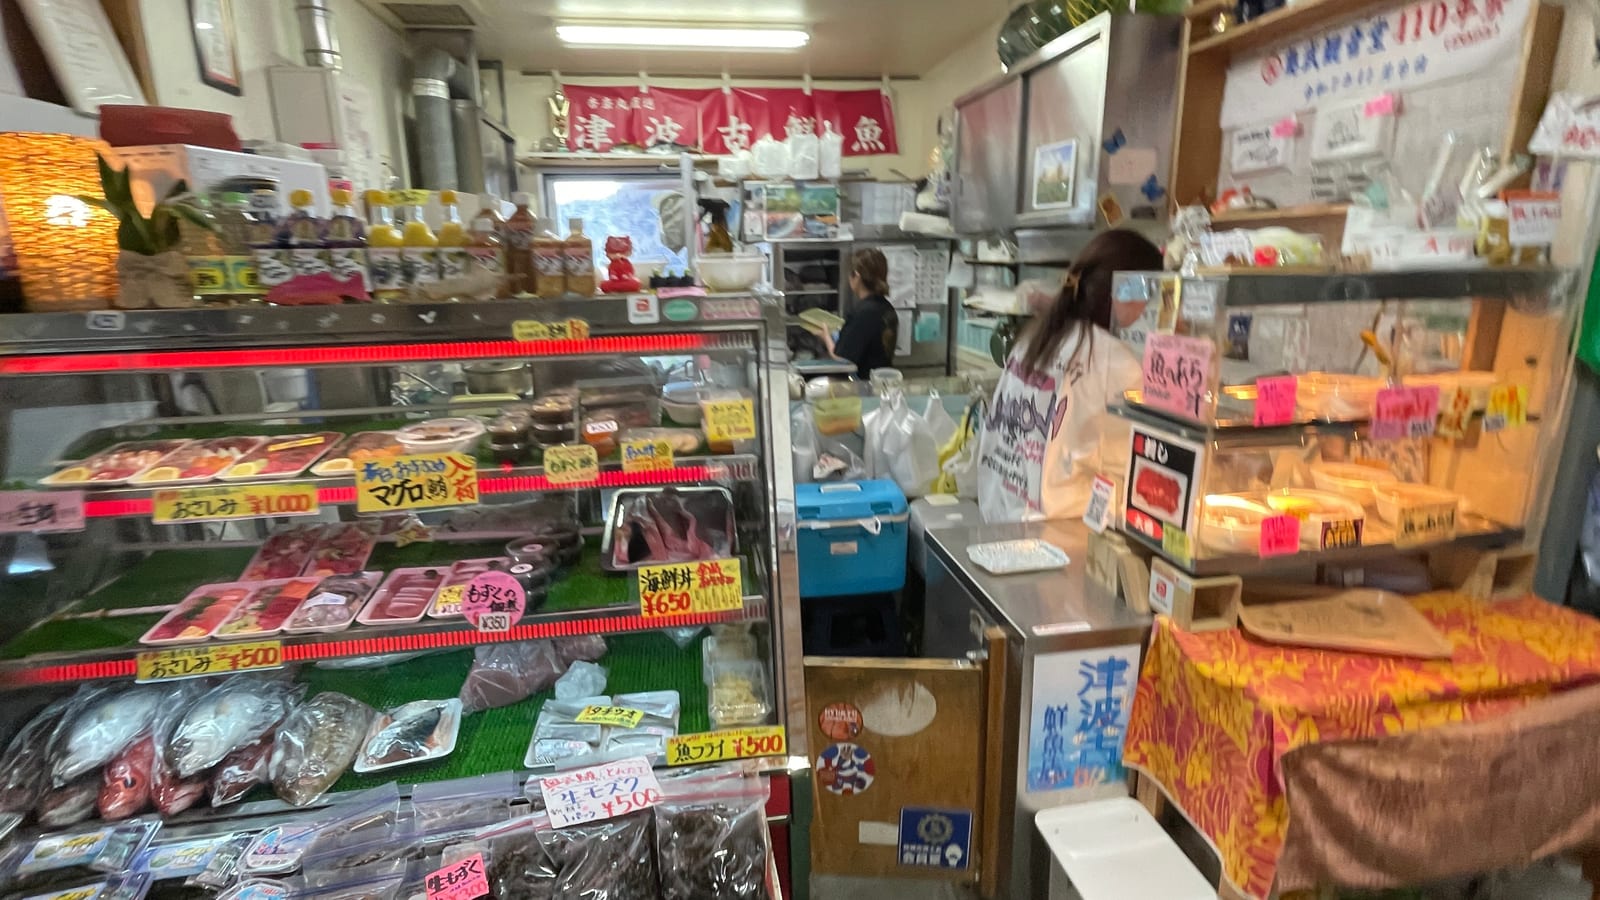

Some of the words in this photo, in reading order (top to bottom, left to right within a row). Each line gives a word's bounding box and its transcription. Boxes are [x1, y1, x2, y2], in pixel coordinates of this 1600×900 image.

[172, 498, 238, 519] おさしみ
[640, 564, 695, 593] 海鮮丼
[468, 583, 517, 604] もずくの
[642, 591, 691, 616] ¥650
[150, 656, 212, 678] おさしみ
[222, 647, 278, 671] ¥500
[674, 740, 725, 763] 魚フライ
[732, 734, 784, 757] ¥500
[561, 777, 640, 805] 生モズク
[601, 788, 661, 819] ¥500
[428, 859, 481, 896] 生もずく
